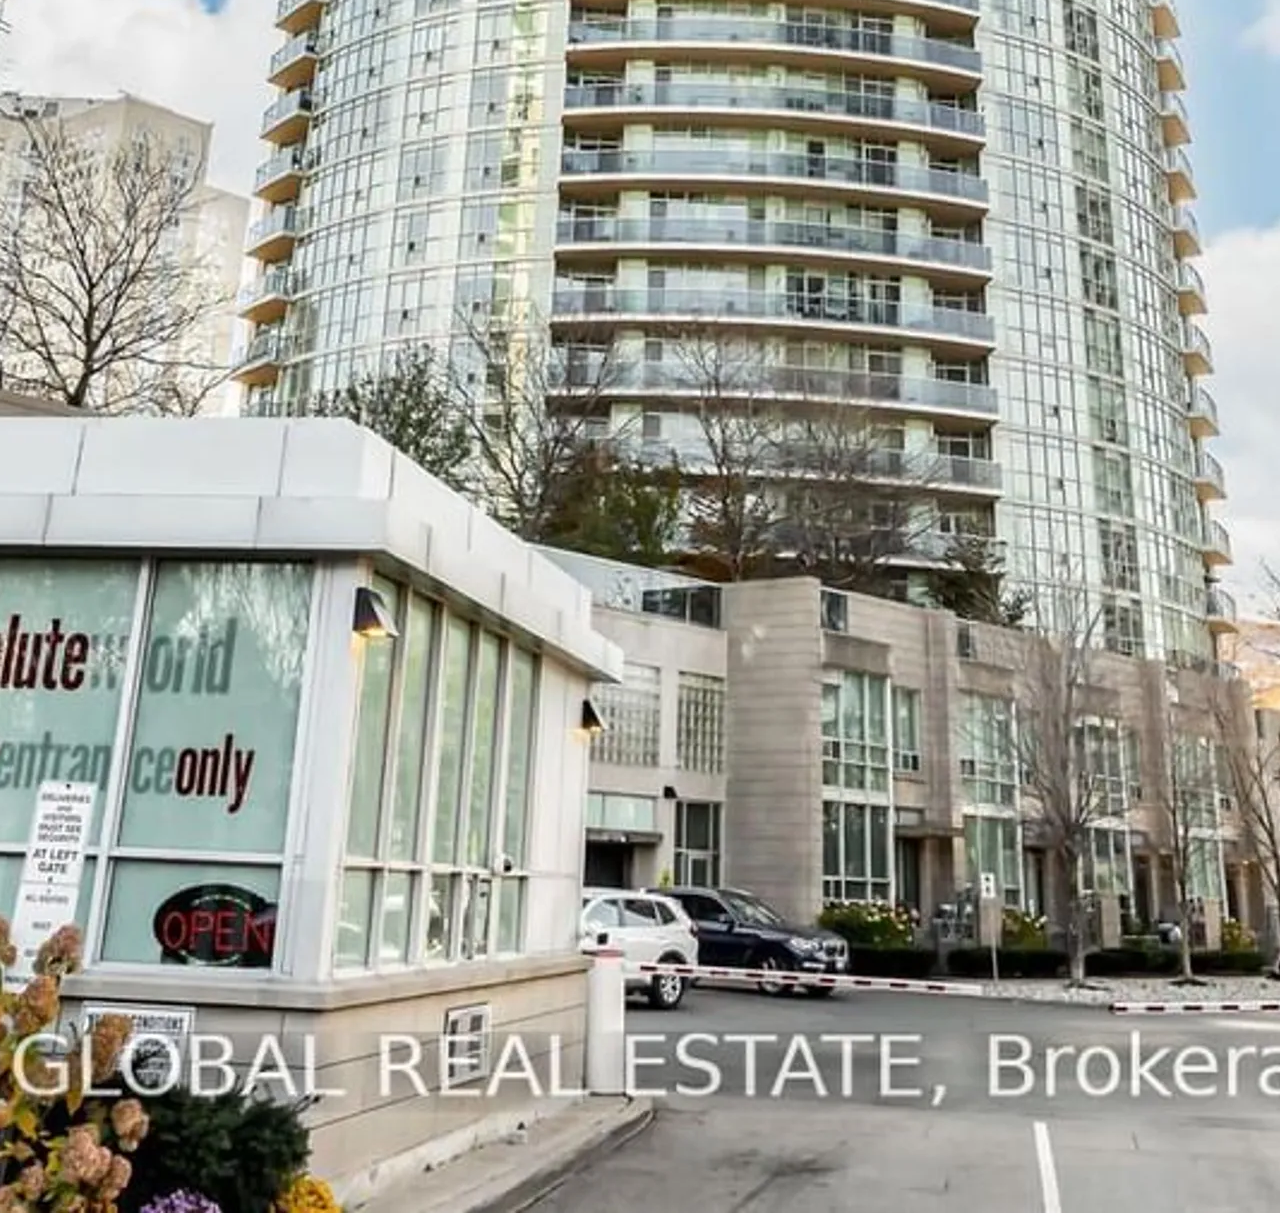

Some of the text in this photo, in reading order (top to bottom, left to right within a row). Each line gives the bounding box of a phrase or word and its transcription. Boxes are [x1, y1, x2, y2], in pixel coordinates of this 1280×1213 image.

[174, 733, 256, 814] only
[33, 848, 78, 862] AT LEFT
[37, 861, 67, 874] GATE
[162, 910, 274, 954] OPEN
